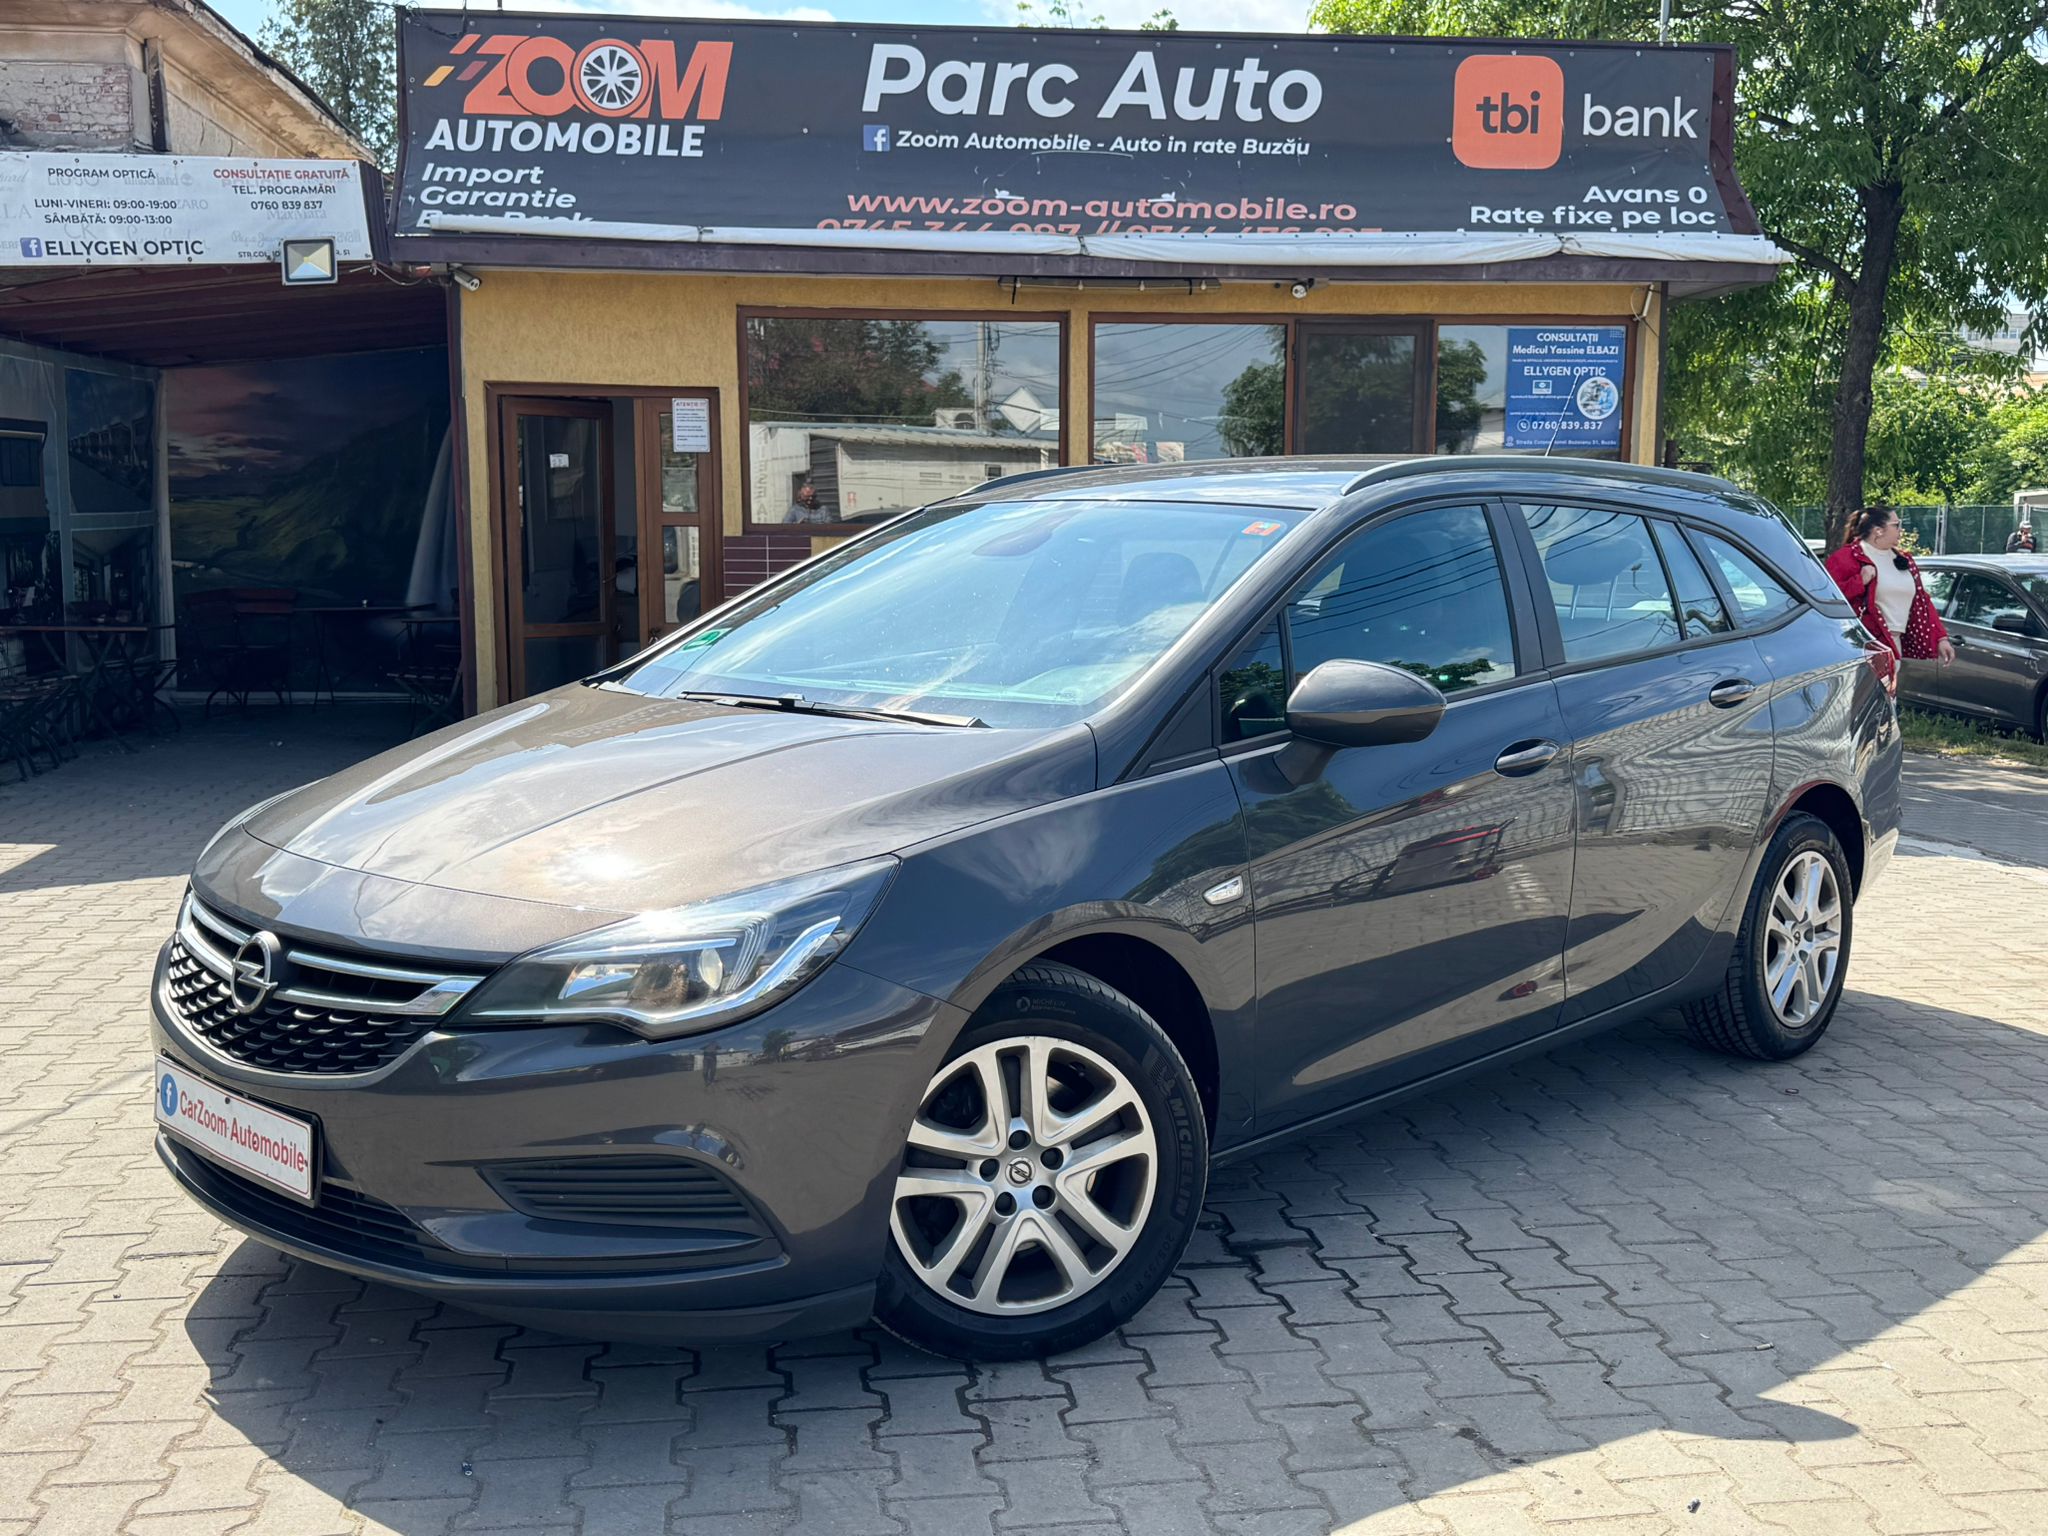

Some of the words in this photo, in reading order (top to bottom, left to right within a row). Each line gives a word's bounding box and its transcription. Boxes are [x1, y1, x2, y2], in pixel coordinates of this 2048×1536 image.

[462, 33, 734, 120] ZOOM
[862, 43, 1080, 119] Parc
[1096, 51, 1323, 122] Auto
[1475, 90, 1541, 134] tbi
[1582, 93, 1698, 139] bank
[424, 118, 706, 157] AUTOMOBILE
[896, 131, 960, 149] Zoom
[964, 132, 1091, 151] Automobile
[1110, 136, 1162, 153] Auto
[1168, 136, 1186, 154] in
[1193, 138, 1237, 154] rate
[1243, 136, 1310, 156] Buzău
[47, 167, 110, 179] PROGRAM
[112, 166, 156, 180] OPTICĂ
[295, 166, 350, 180] GRATUITĂ
[420, 163, 544, 188] Import
[232, 184, 257, 195] TEL.
[259, 182, 336, 195] PROGRAMĂRI
[419, 186, 577, 209] Garantie
[1582, 185, 1680, 203] Avans
[1688, 186, 1708, 203] 0
[34, 198, 111, 210] LUNI-VINERI:
[113, 199, 177, 210] 09:00-19:00
[251, 199, 279, 210] 0760
[281, 199, 301, 210] 839
[303, 200, 323, 210] 837
[848, 192, 1358, 222] www.zoom-automobile.ro
[44, 211, 107, 224] SÂMBĂTĂ:
[109, 214, 173, 225] 09:00-13:00
[1470, 206, 1545, 224] Rate
[1551, 205, 1613, 224] fixe
[1622, 209, 1661, 229] pe
[1671, 206, 1717, 225] loc
[46, 240, 142, 256] ELLYGEN
[147, 240, 204, 256] OPTIC
[1536, 332, 1599, 344] CONSULTAȚII
[1512, 345, 1548, 355] Medicul
[1549, 345, 1584, 355] Yassine
[1586, 346, 1619, 355] ELBAZI
[1523, 366, 1571, 376] ELLYGEN
[1573, 366, 1606, 377] OPTIC
[1532, 421, 1603, 430] 0760839.837
[179, 1090, 227, 1137] CarZoom
[230, 1117, 305, 1173] Automobile
[1168, 1096, 1195, 1217] MICHELIN
